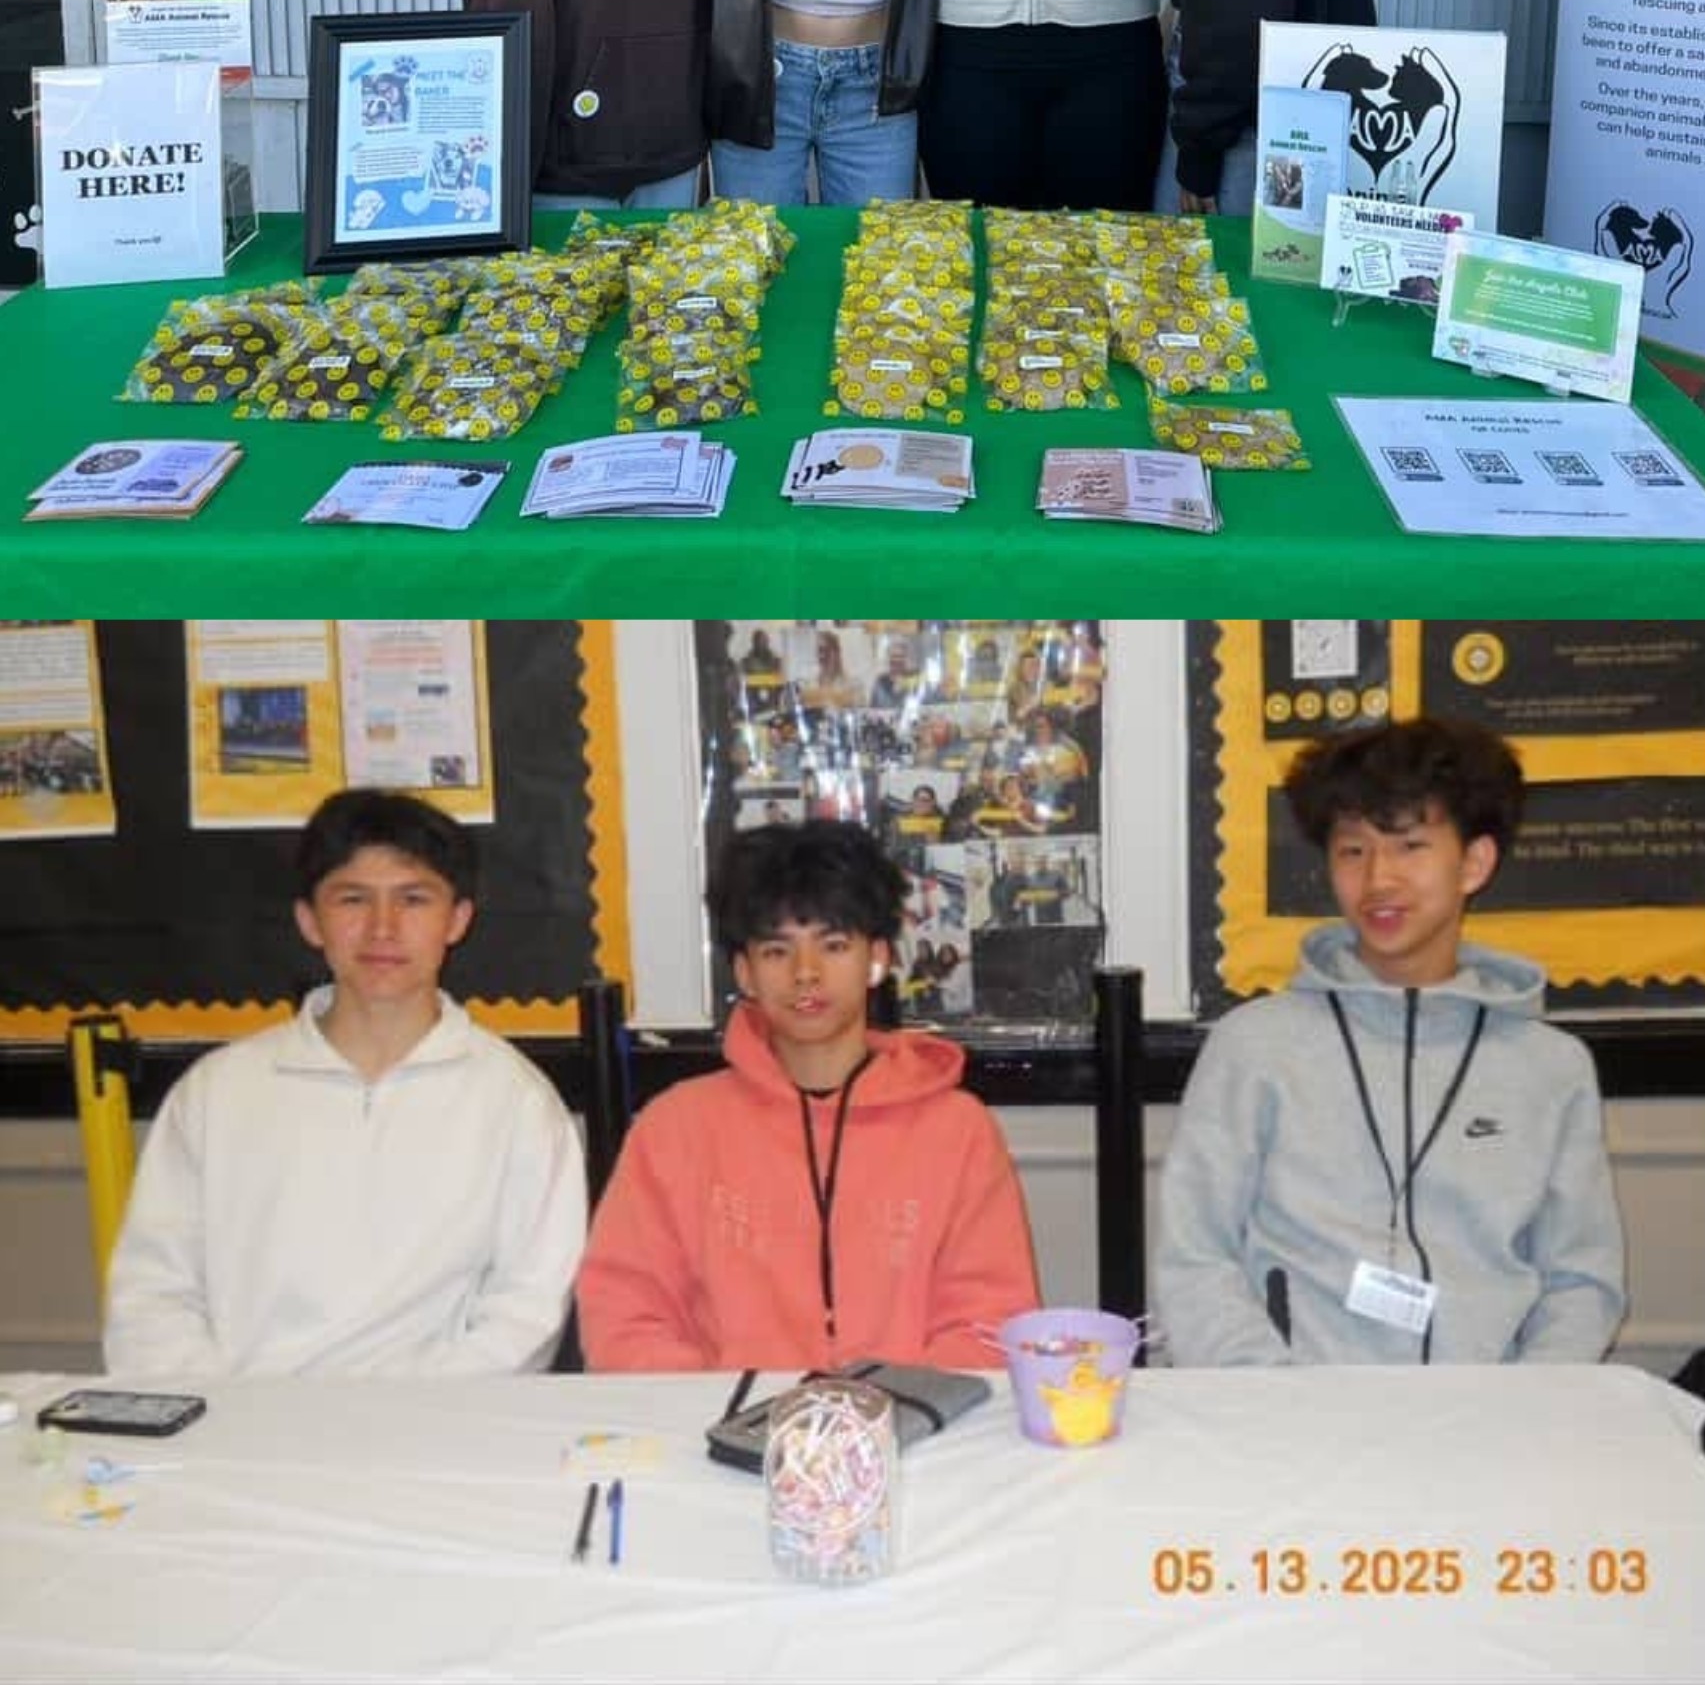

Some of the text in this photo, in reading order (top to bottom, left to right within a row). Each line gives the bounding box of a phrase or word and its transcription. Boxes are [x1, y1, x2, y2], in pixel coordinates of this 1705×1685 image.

[1579, 99, 1657, 123] companion
[61, 141, 203, 171] DONATE
[76, 170, 186, 200] HERE!
